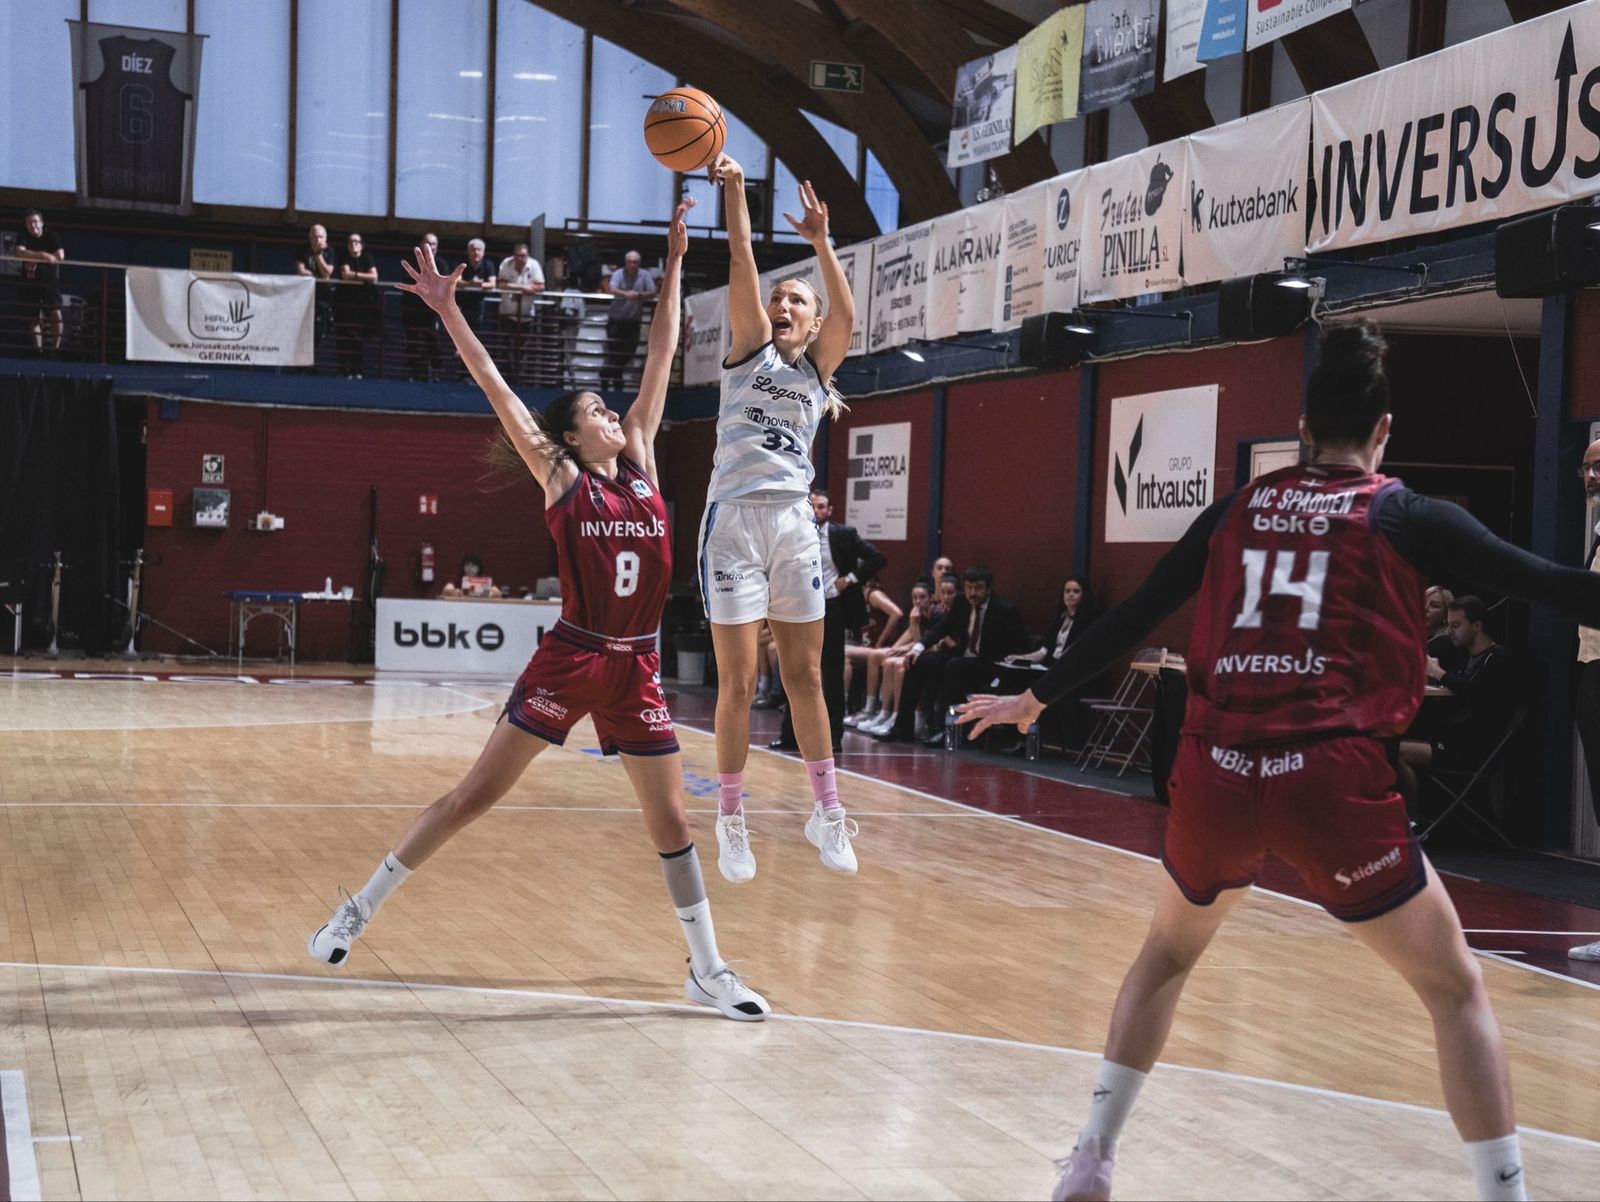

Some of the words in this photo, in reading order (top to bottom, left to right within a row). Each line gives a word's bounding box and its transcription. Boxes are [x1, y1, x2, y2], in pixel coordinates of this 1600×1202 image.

[1256, 2, 1304, 35] Sustainable
[121, 52, 153, 74] DÍEZ
[119, 84, 154, 145] 6
[1321, 19, 1600, 235] INVERSUS
[1208, 179, 1299, 230] kutxabank
[1043, 238, 1081, 270] URICH
[1102, 224, 1161, 275] PINILLA
[198, 350, 252, 362] GERNIKA
[761, 428, 802, 456] 32
[1168, 456, 1193, 472] GRUPO
[1136, 467, 1208, 510] Intxausti
[1247, 486, 1278, 509] MC
[580, 514, 666, 537] INVERSUS
[614, 551, 640, 597] 8
[1232, 549, 1331, 630] 14
[393, 621, 471, 649] bbk
[1213, 647, 1327, 675] INVERSUS
